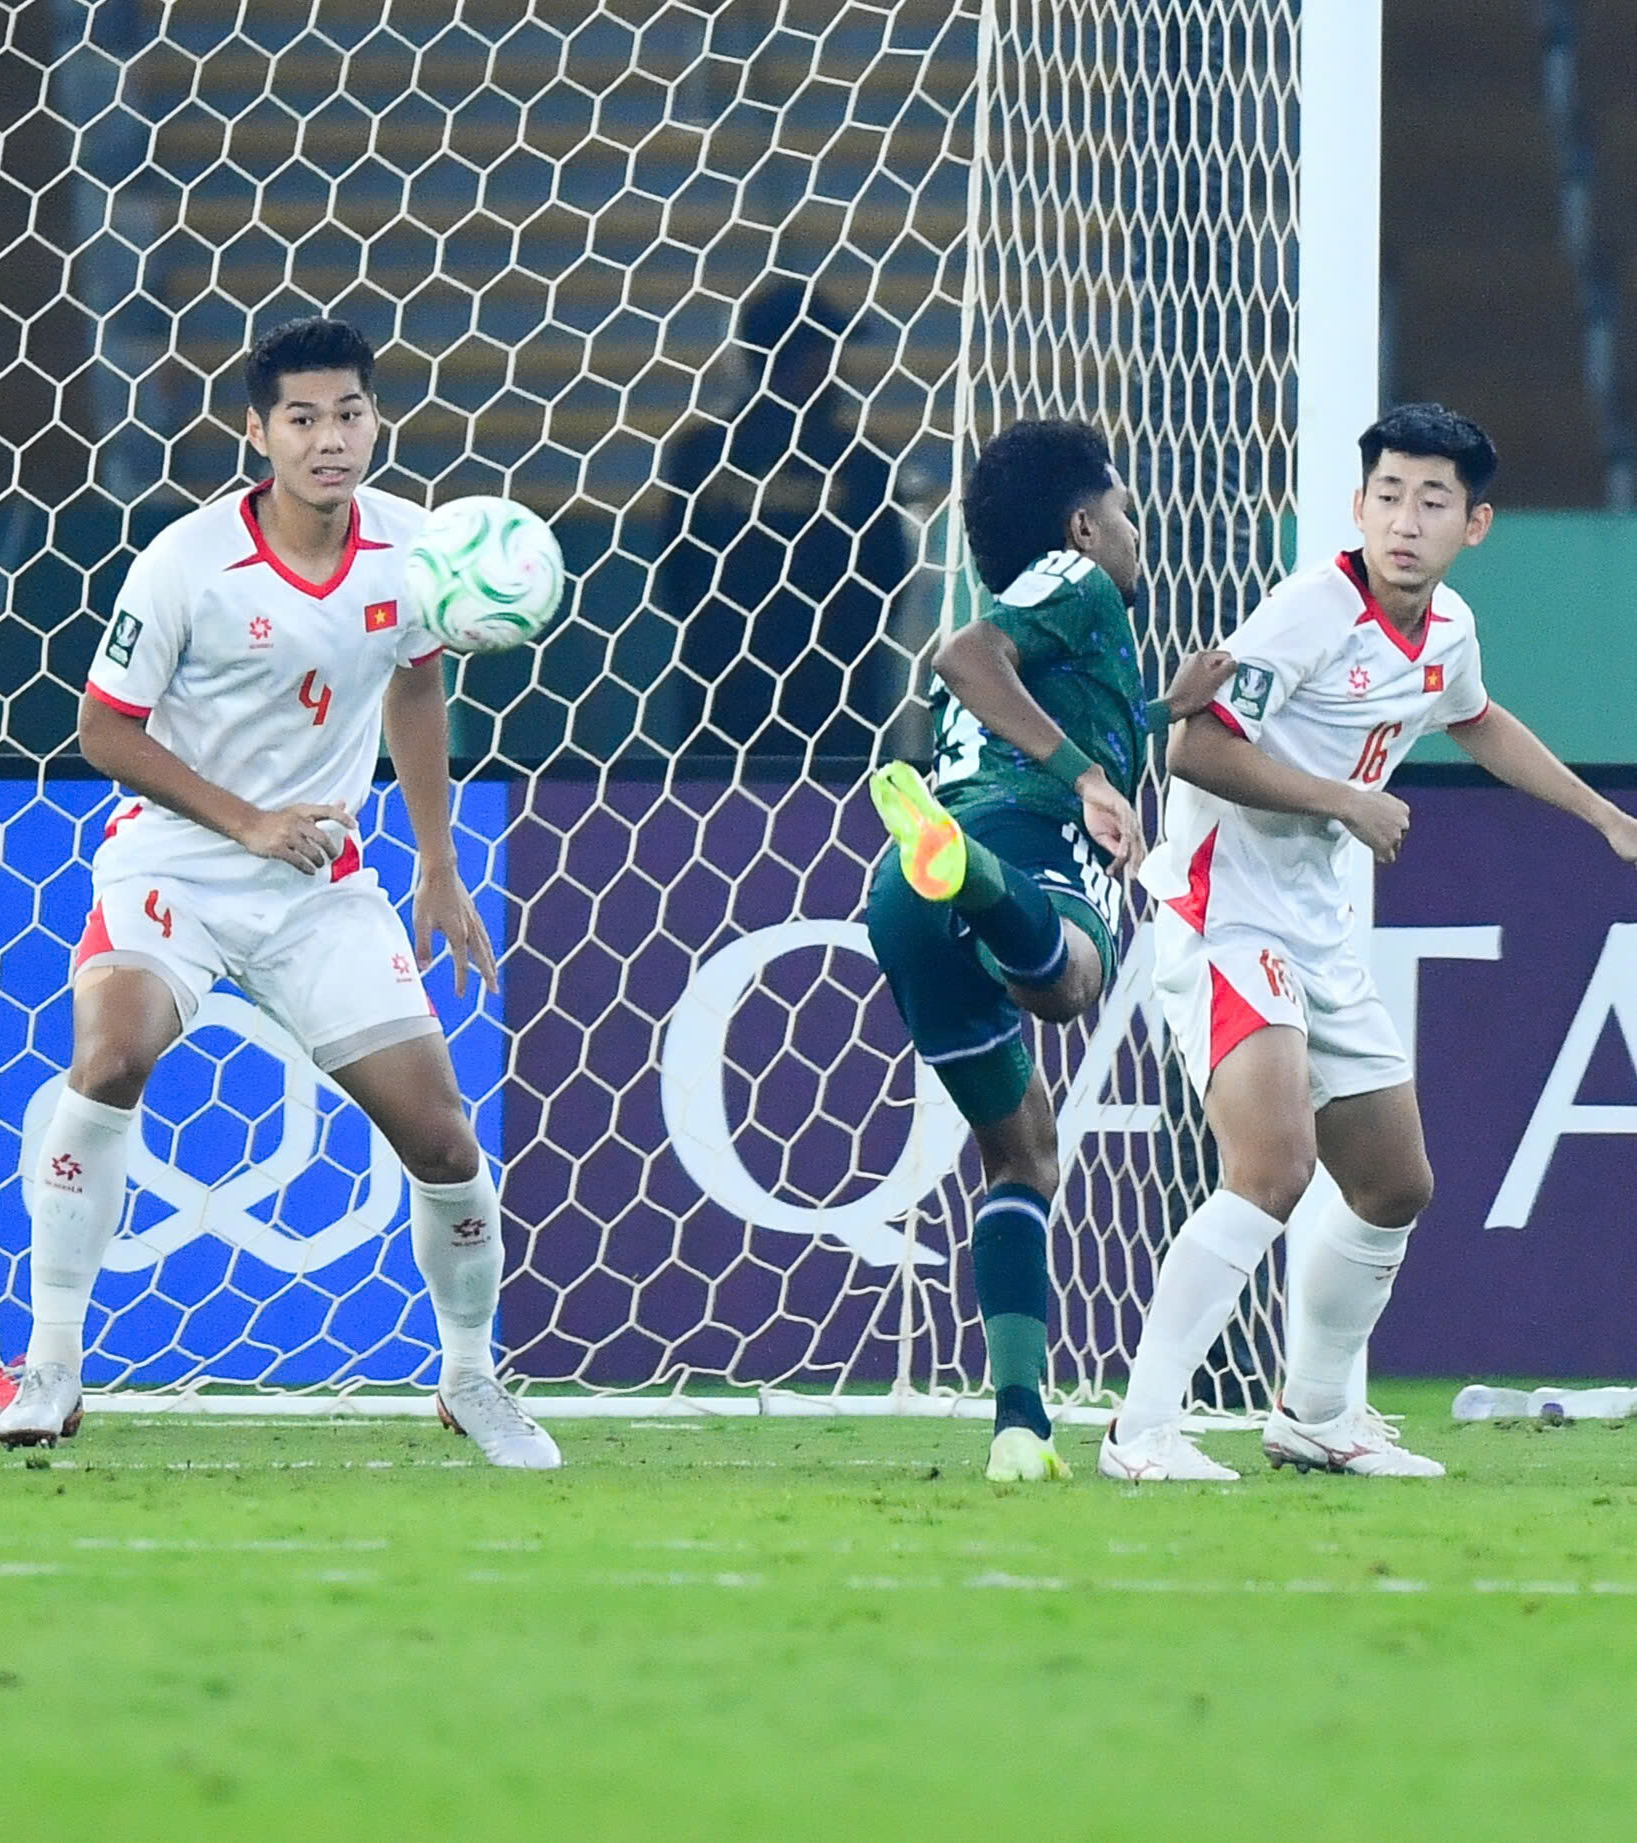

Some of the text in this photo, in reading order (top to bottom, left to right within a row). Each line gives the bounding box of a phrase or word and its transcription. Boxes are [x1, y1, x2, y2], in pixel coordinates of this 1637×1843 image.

[298, 668, 332, 726] 4
[1347, 720, 1402, 784] 16
[144, 889, 172, 938] 4
